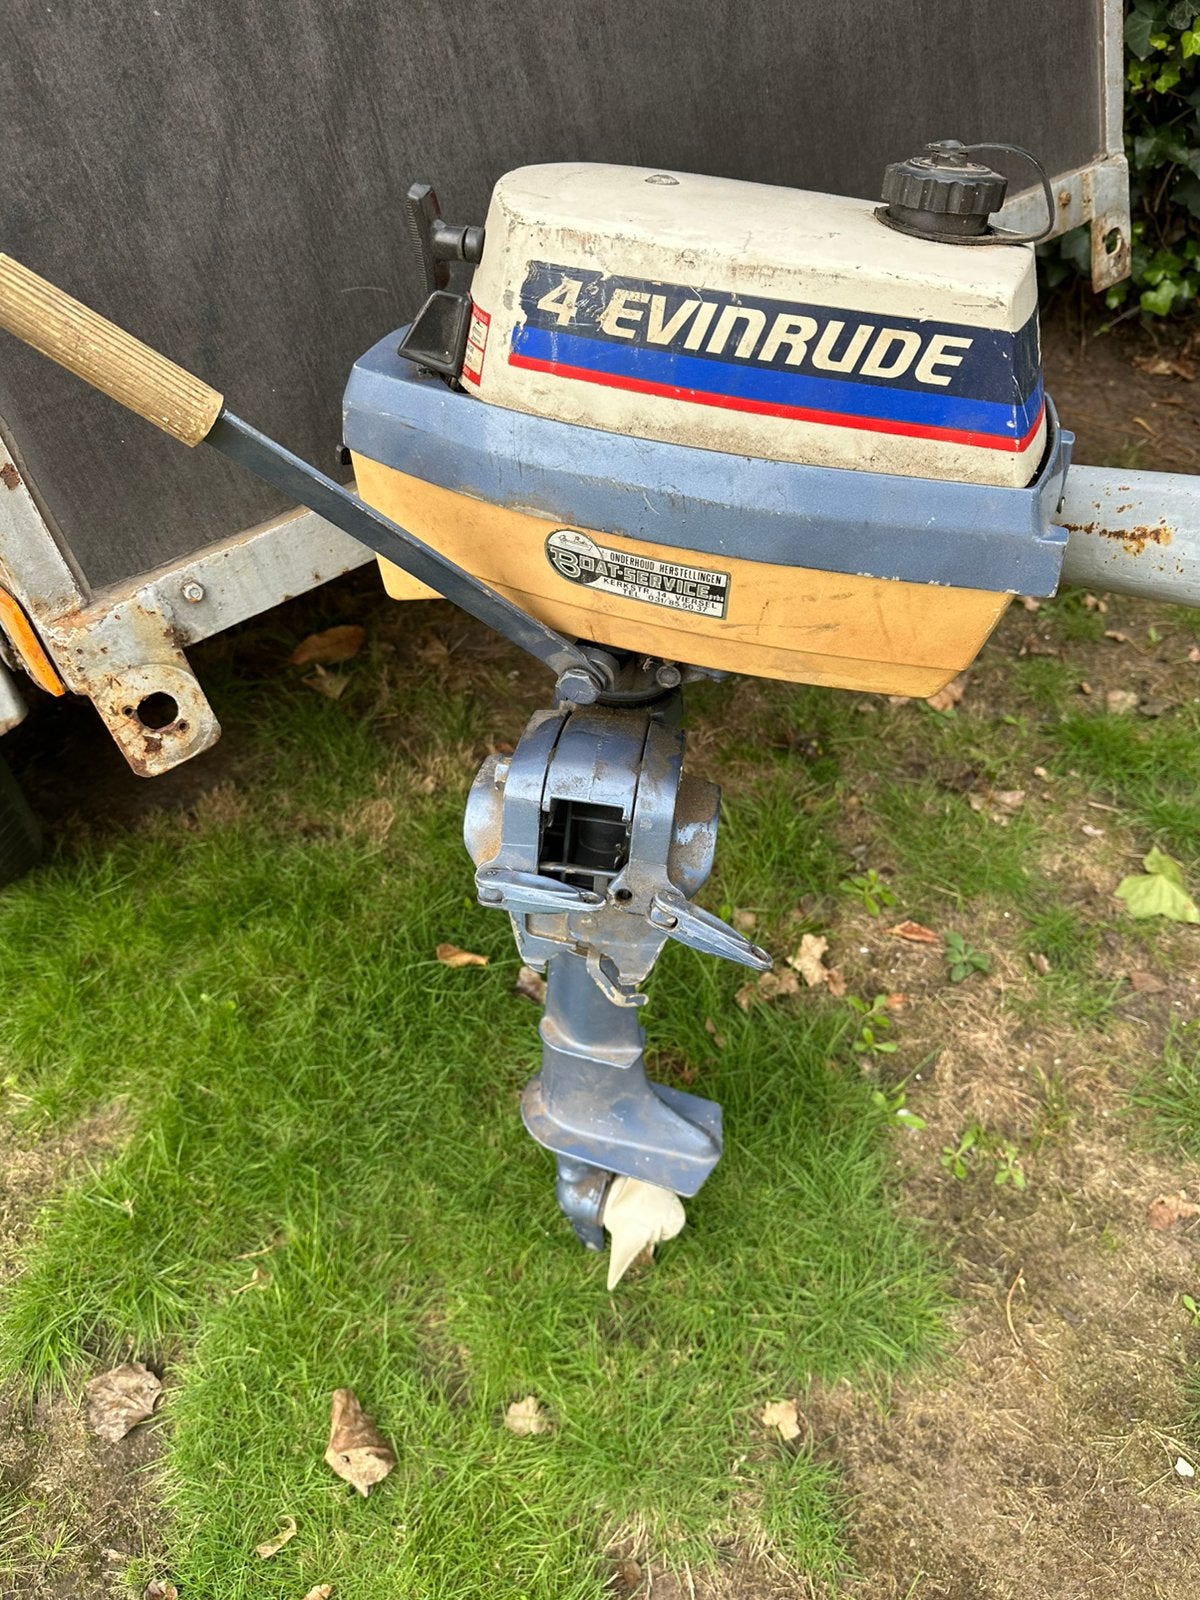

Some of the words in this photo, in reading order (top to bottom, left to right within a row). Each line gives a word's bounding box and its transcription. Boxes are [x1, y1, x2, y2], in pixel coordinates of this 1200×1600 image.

[537, 276, 583, 326] 4
[601, 289, 974, 387] EVINRUDE
[610, 552, 655, 571] ONDERHOUD
[659, 563, 722, 585] HERSTELLINGEN
[675, 595, 718, 610] VIERSEL
